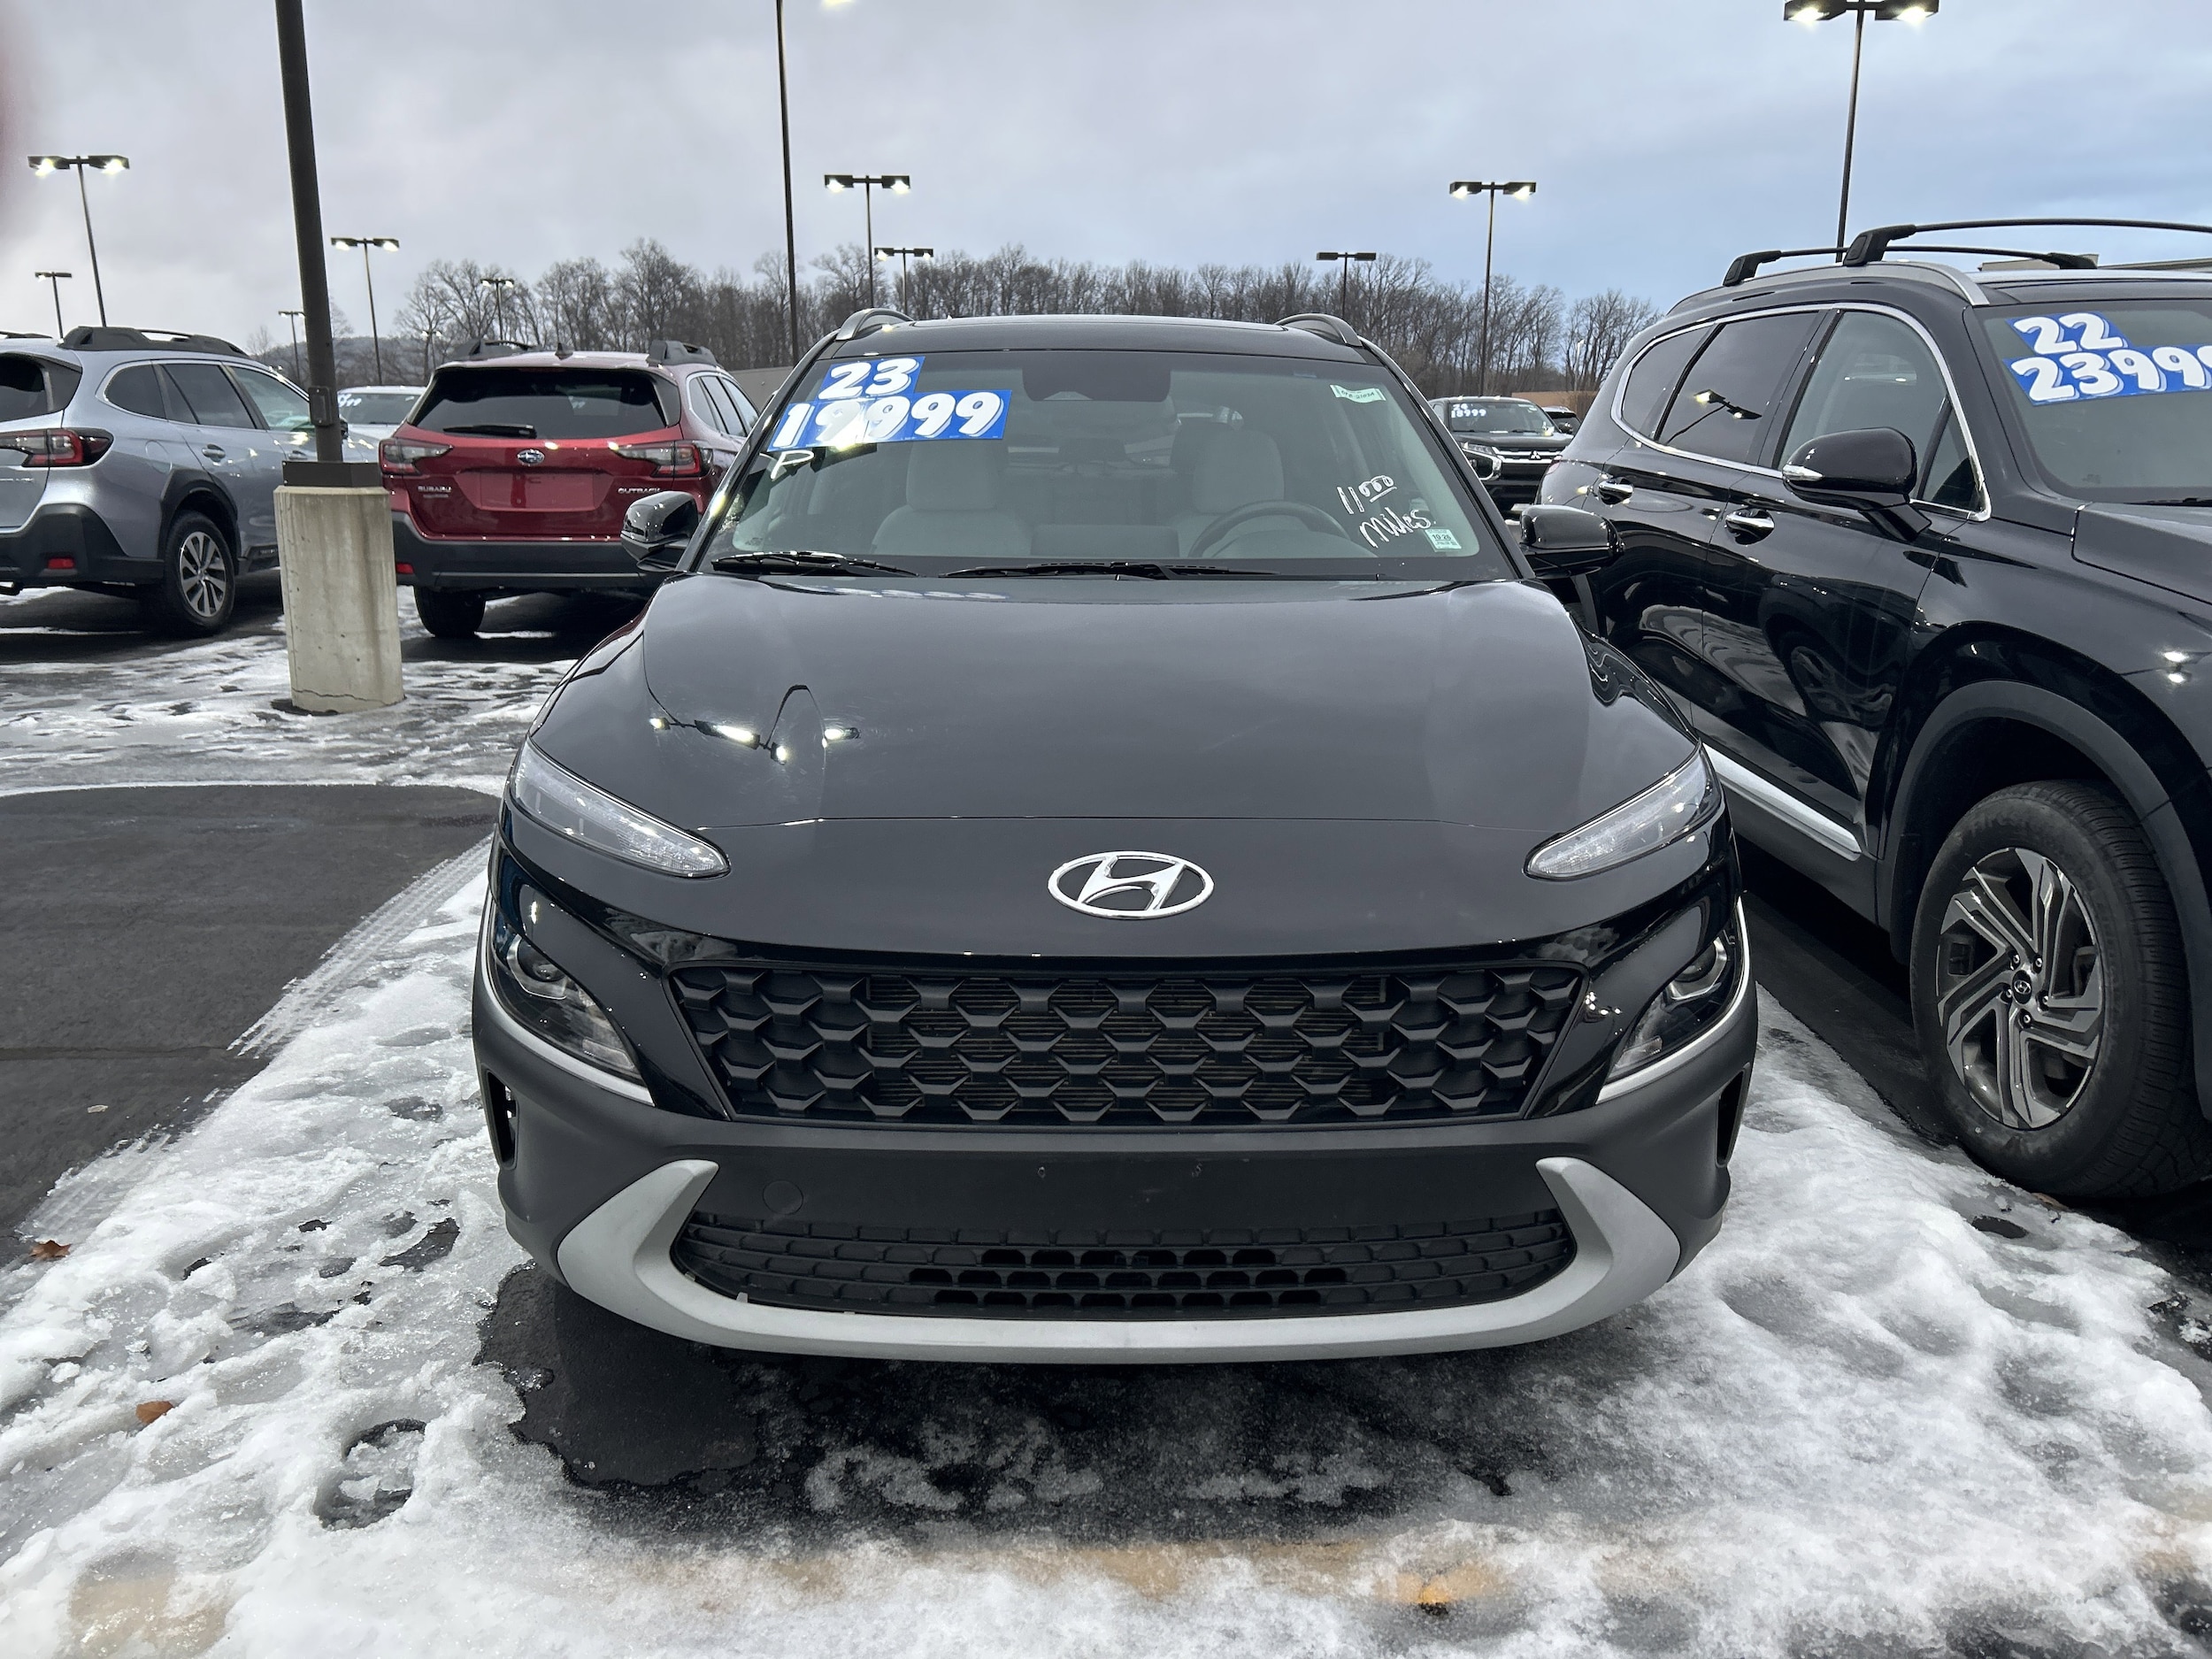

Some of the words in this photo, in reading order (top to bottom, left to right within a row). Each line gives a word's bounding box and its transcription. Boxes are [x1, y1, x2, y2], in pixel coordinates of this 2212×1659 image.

[2013, 312, 2128, 354] 22
[818, 357, 919, 400] 23
[2010, 346, 2212, 402] 2399
[772, 392, 1004, 448] 19999
[1451, 409, 1486, 419] 18999
